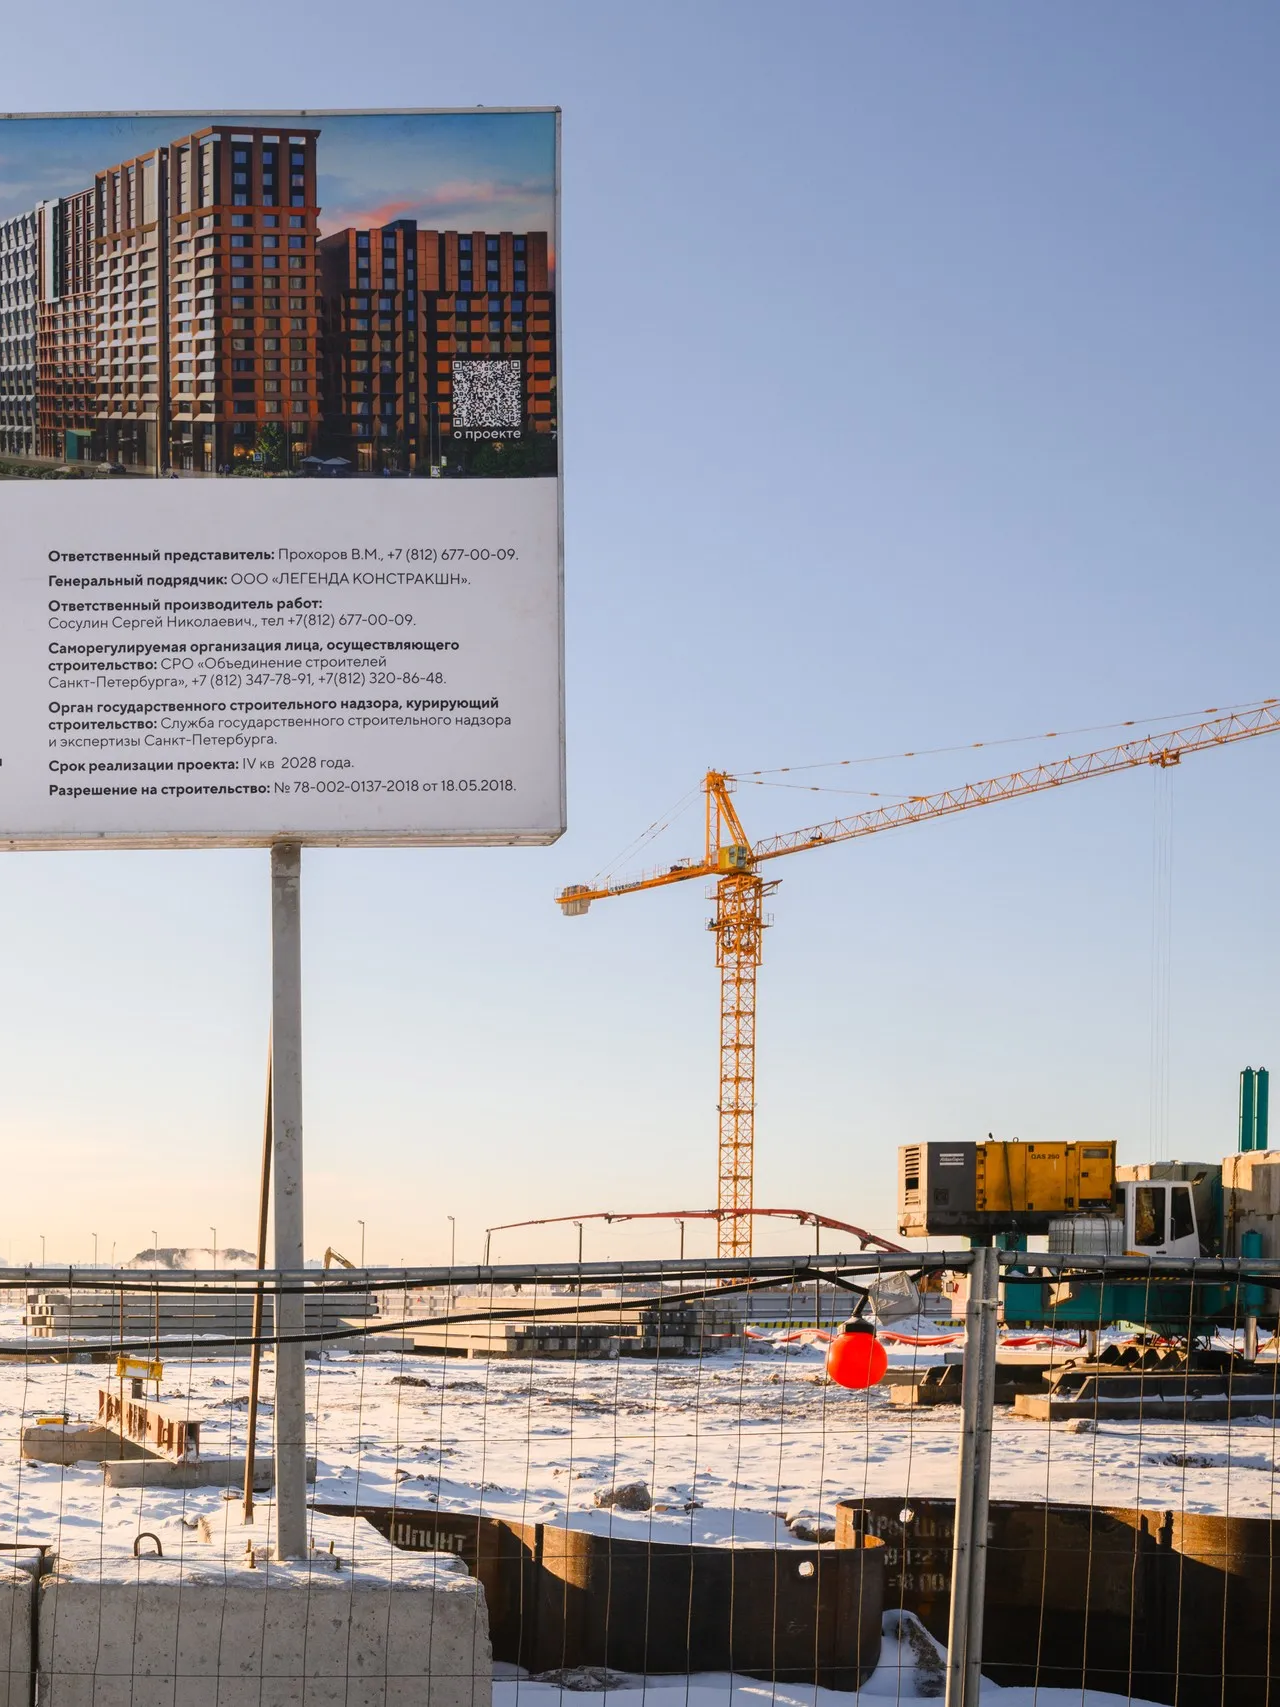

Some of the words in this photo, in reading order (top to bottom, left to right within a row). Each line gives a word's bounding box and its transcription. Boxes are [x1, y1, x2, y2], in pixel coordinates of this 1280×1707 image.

[453, 430, 462, 439] о
[465, 430, 521, 442] проекте
[47, 548, 161, 562] Ответственный
[163, 550, 275, 564] представитель:
[278, 547, 348, 563] Прохоров
[351, 547, 384, 562] В.М.,
[387, 548, 403, 560] +7
[405, 548, 438, 564] (812)
[440, 547, 519, 561] 677-00-09.
[48, 573, 143, 590] Генеральный
[146, 575, 228, 589] подрядчик:
[230, 572, 269, 585] ООО
[271, 571, 350, 586] «ЛЕГЕНДА
[352, 572, 471, 585] КОНСТРАКШН».
[47, 598, 161, 612] Ответственный
[164, 600, 274, 614] производитель
[276, 596, 322, 612] работ:
[47, 616, 108, 632] Сосулин
[111, 615, 163, 631] Сергей
[166, 615, 258, 628] Николаевич.,
[260, 617, 284, 627] тел
[287, 613, 335, 629] +7(812)
[338, 613, 416, 626] 677-00-09.
[48, 641, 187, 657] Саморегулируемая
[189, 642, 282, 655] организация
[284, 641, 323, 652] лица,
[326, 641, 460, 654] осуществляющего
[47, 660, 157, 674] строительство:
[160, 657, 194, 670] СРО
[197, 656, 302, 670] «Объединение
[305, 655, 387, 671] строителей
[48, 674, 188, 691] Санкт-Петербурга»,
[191, 674, 207, 686] +7
[210, 673, 242, 690] (812)
[245, 672, 315, 686] 347-78-91,
[317, 671, 366, 687] +7(812)
[368, 671, 447, 684] 320-86-48.
[48, 701, 93, 717] Орган
[96, 702, 227, 716] государственного
[229, 700, 337, 714] строительного
[340, 699, 403, 712] надзора,
[405, 696, 499, 712] курирующий
[47, 720, 157, 734] строительство:
[160, 716, 214, 732] Служба
[218, 716, 345, 731] государственного
[347, 716, 452, 729] строительного
[455, 716, 511, 728] надзора
[48, 738, 57, 747] и
[59, 737, 141, 750] экспертизы
[143, 732, 277, 748] Санкт-Петербурга.
[48, 759, 86, 775] Срок
[88, 761, 173, 775] реализации
[176, 760, 239, 774] проекта:
[242, 757, 257, 769] IV
[259, 760, 275, 769] кв
[280, 756, 317, 769] 2028
[320, 758, 354, 770] года.
[48, 784, 138, 799] Разрешение
[140, 785, 158, 795] на
[160, 784, 270, 798] строительство:
[274, 781, 291, 794] №
[293, 779, 419, 793] 78-002-0137-2018
[422, 782, 438, 792] от
[440, 778, 517, 792] 18.05.2018.
